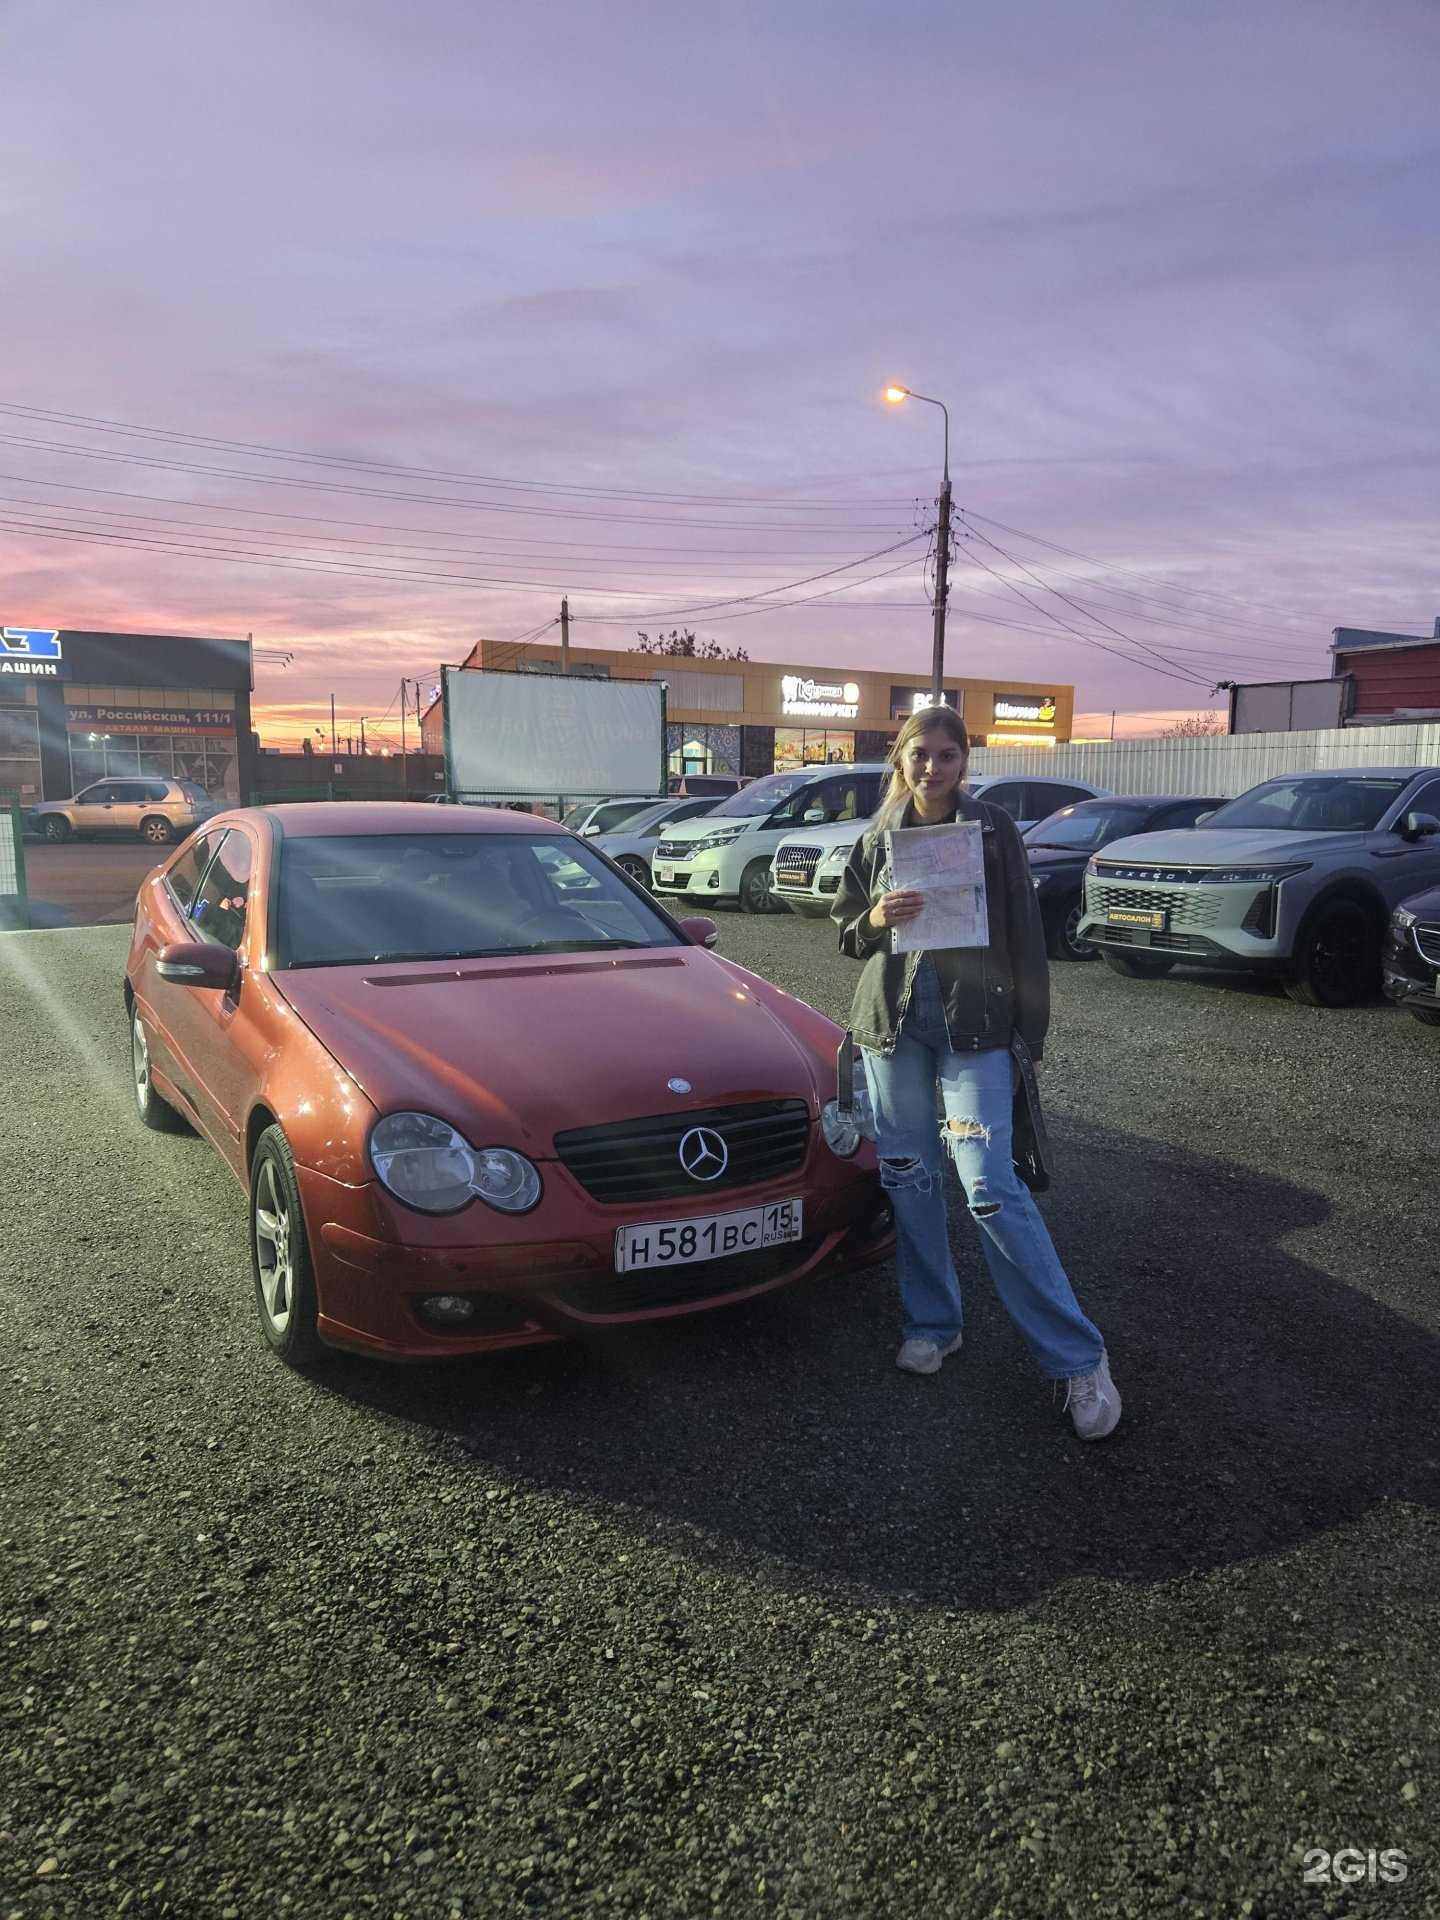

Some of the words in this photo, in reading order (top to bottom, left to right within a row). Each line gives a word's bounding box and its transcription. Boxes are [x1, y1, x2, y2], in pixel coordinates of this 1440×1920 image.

[0, 662, 57, 675] АШИН
[69, 708, 92, 721] ул.
[97, 708, 190, 724] Российская,
[195, 712, 231, 723] 111/1
[1109, 913, 1151, 923] АВТОСАЛОН
[768, 1204, 792, 1231] 15
[631, 1221, 758, 1264] Н581ВС
[763, 1231, 784, 1243] RUS
